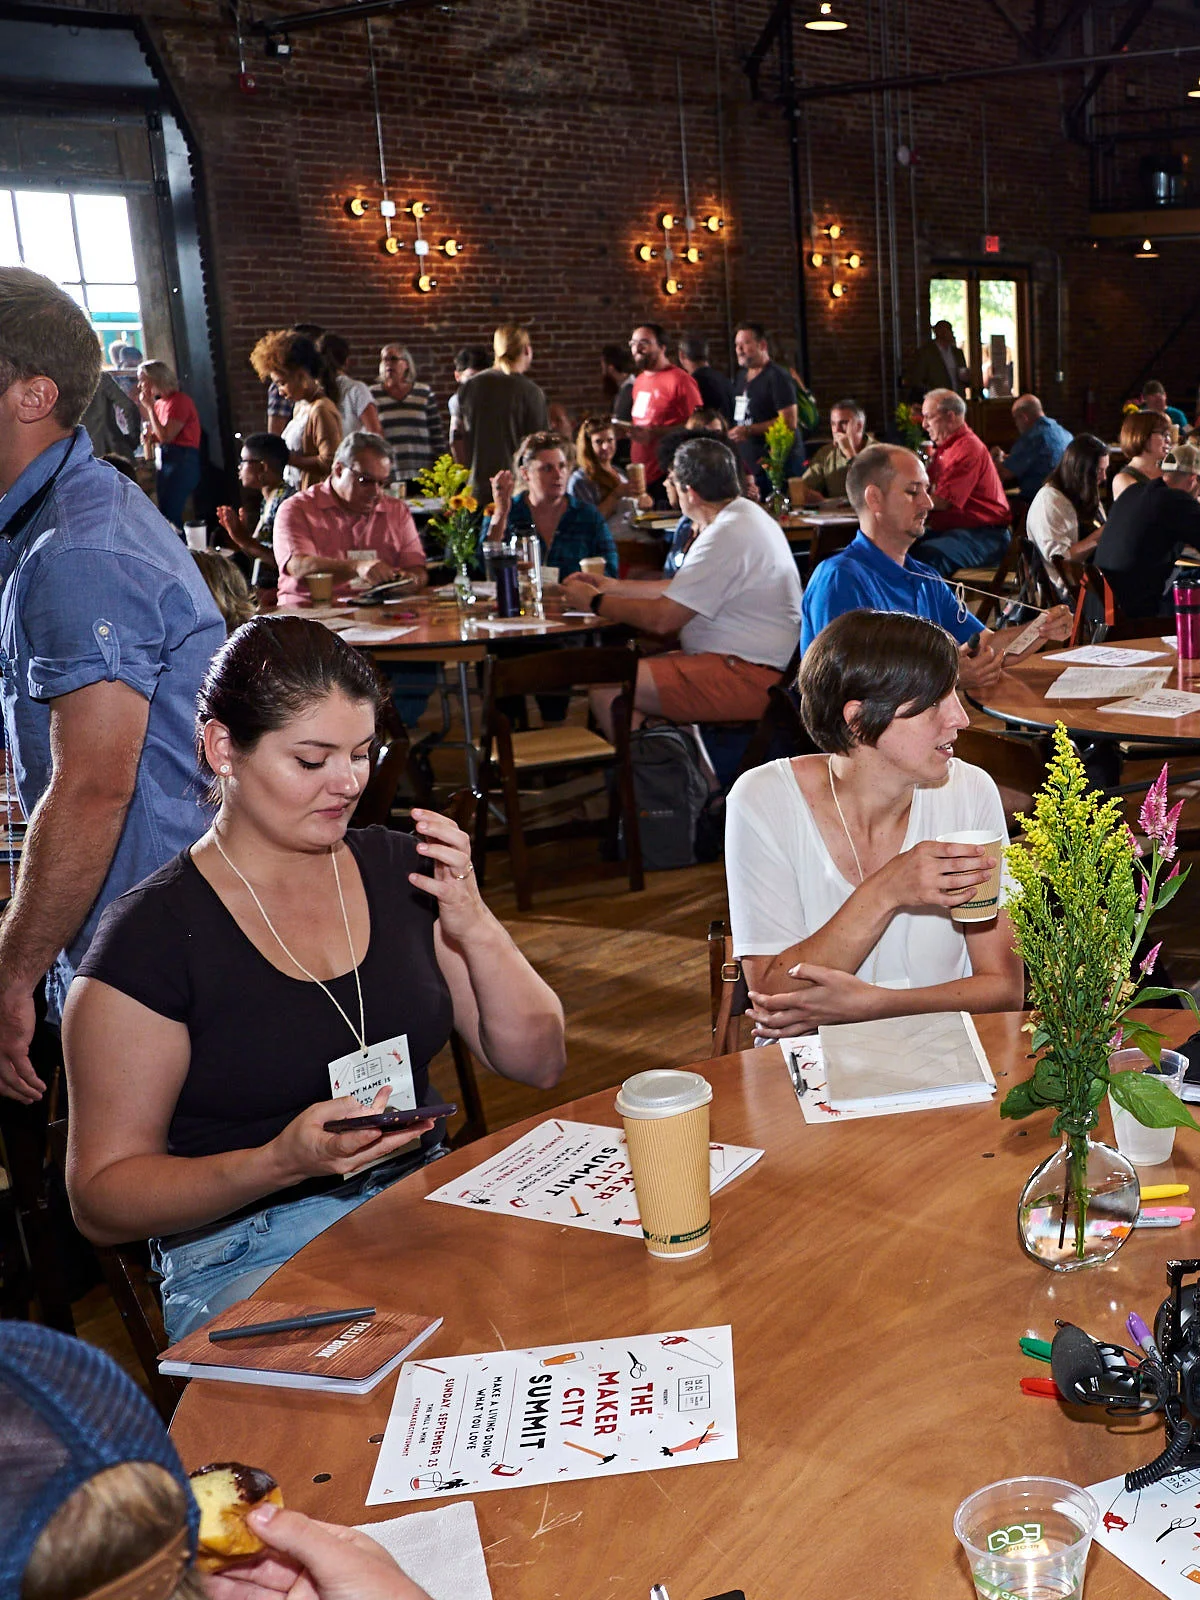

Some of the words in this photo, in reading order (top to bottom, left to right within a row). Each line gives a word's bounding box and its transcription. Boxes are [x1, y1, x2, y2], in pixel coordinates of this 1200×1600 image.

[350, 1088, 359, 1096] MY
[362, 1079, 382, 1091] NAME
[384, 1075, 391, 1083] IS
[549, 1147, 575, 1161] WHAT
[567, 1141, 593, 1156] MAKE
[493, 1156, 536, 1181] SEPTEMBER
[533, 1162, 552, 1173] YOU
[538, 1162, 565, 1177] LIVING
[539, 1146, 622, 1197] SUMMIT
[579, 1160, 629, 1190] CITY
[514, 1177, 541, 1192] DOING
[515, 1173, 536, 1184] LOVE
[591, 1171, 642, 1201] KER
[343, 1321, 372, 1342] FIELD
[315, 1338, 345, 1359] BOOK
[490, 1375, 503, 1398] MAKE
[425, 1403, 433, 1413] THE
[473, 1388, 486, 1411] WHAT
[488, 1399, 499, 1407] A
[558, 1386, 585, 1430] CITY
[593, 1370, 620, 1436] MAKER
[629, 1382, 653, 1416] THE
[470, 1413, 482, 1429] YOU
[484, 1408, 498, 1432] LIVING
[518, 1373, 552, 1451] SUMMIT
[429, 1412, 448, 1455] SEPTEMBER
[466, 1430, 478, 1450] LOVE
[479, 1434, 493, 1459] DOING
[426, 1458, 438, 1468] 23
